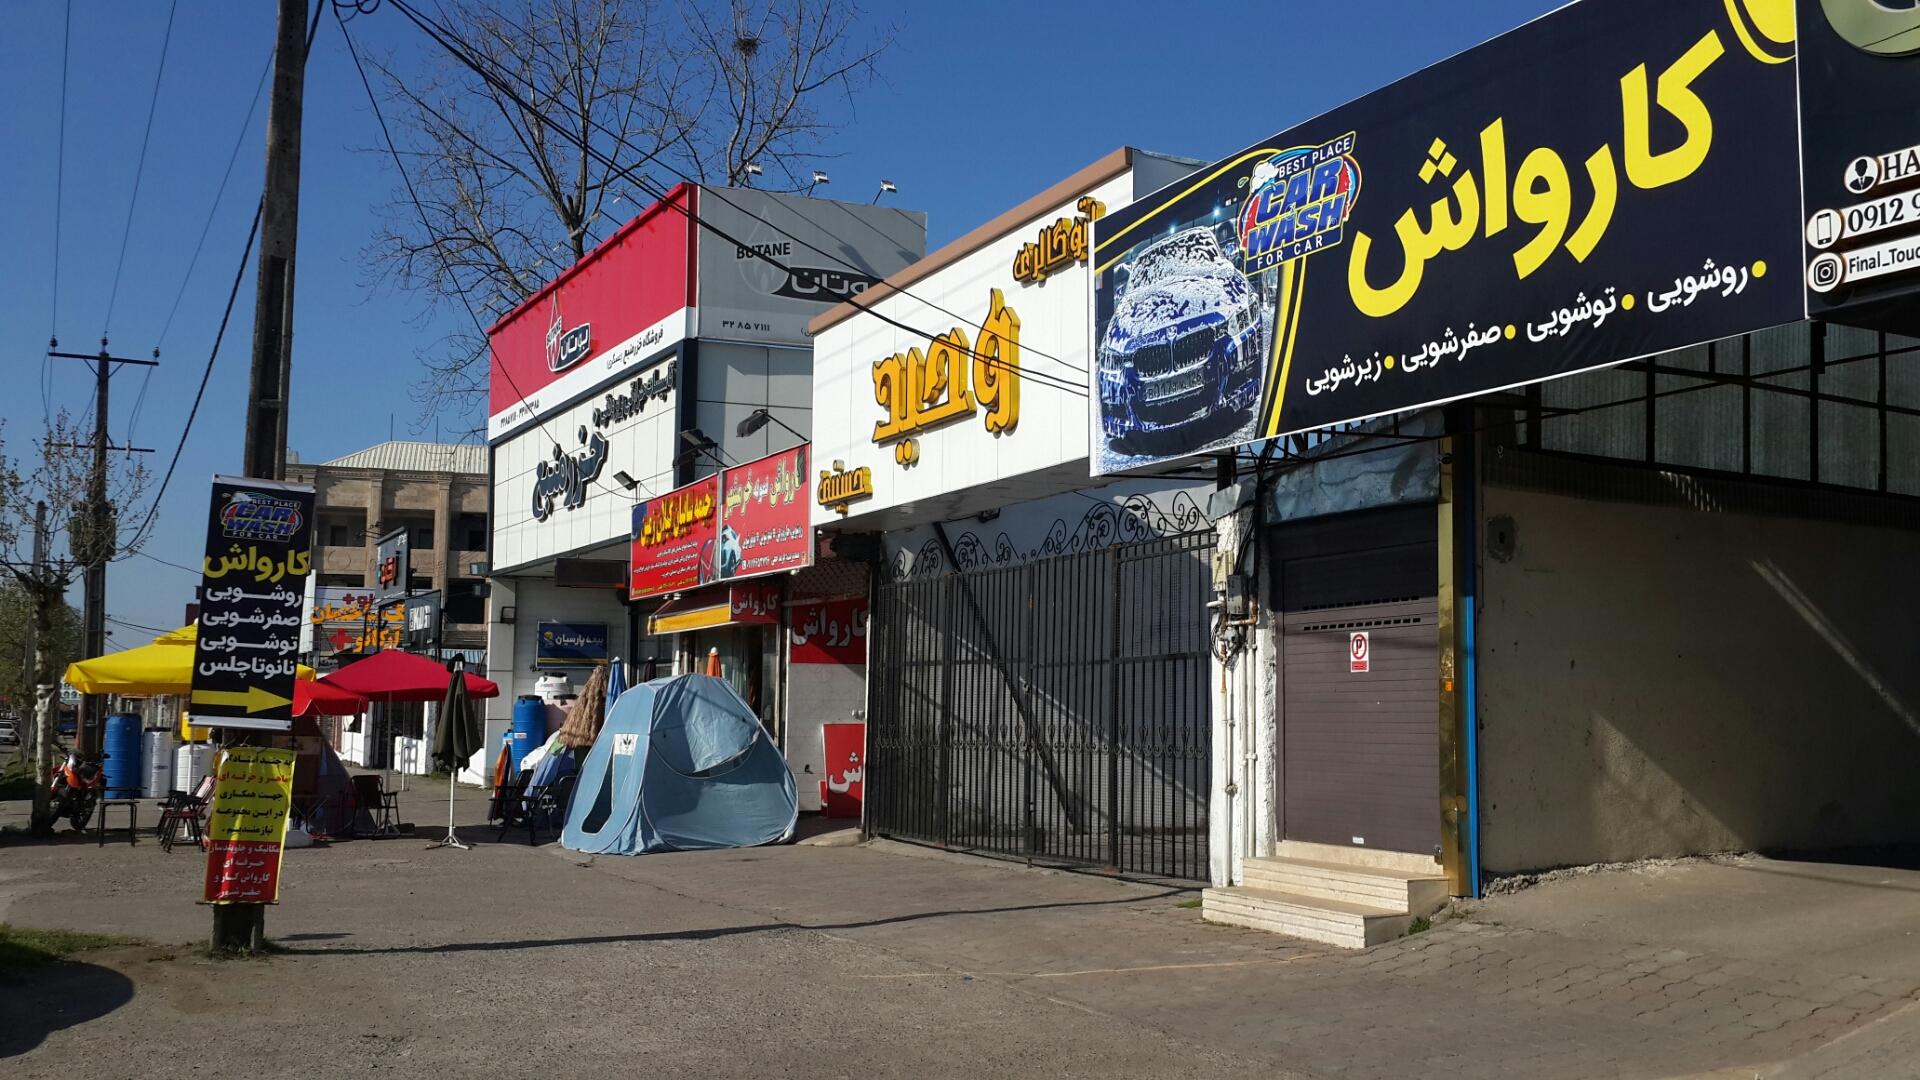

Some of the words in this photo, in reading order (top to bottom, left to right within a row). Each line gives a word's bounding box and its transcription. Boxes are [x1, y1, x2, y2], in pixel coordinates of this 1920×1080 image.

[1279, 156, 1307, 179] BEST
[1311, 137, 1351, 164] PLACE
[1347, 29, 1726, 317] کارواش
[1255, 156, 1343, 225] CAR
[1246, 193, 1347, 261] WASH
[1847, 198, 1904, 233] 0912
[736, 242, 791, 260] BUTANE
[1257, 250, 1284, 270] FOR
[1293, 235, 1323, 255] CAR
[790, 271, 869, 296] وتان
[1647, 257, 1748, 314] روشویی
[1526, 286, 1617, 342] توشویی
[1401, 321, 1502, 374] صفرشویی
[1305, 351, 1382, 396] زیرشویی
[235, 503, 294, 523] CAR
[274, 500, 299, 508] PLACE
[225, 518, 294, 536] WASH
[203, 543, 309, 583] کارواش
[206, 584, 303, 608] روشویی
[731, 590, 779, 616] کارواش
[202, 607, 300, 630] صفرشویی
[792, 607, 868, 647] کارواش
[200, 633, 298, 656] توشویی
[554, 633, 586, 648] پارسیان
[199, 655, 295, 680] نانوتاچلس
[220, 789, 256, 800] همکاری
[258, 792, 283, 802] جهت
[216, 806, 251, 818] مجموعه
[252, 808, 273, 818] این
[274, 809, 284, 820] در
